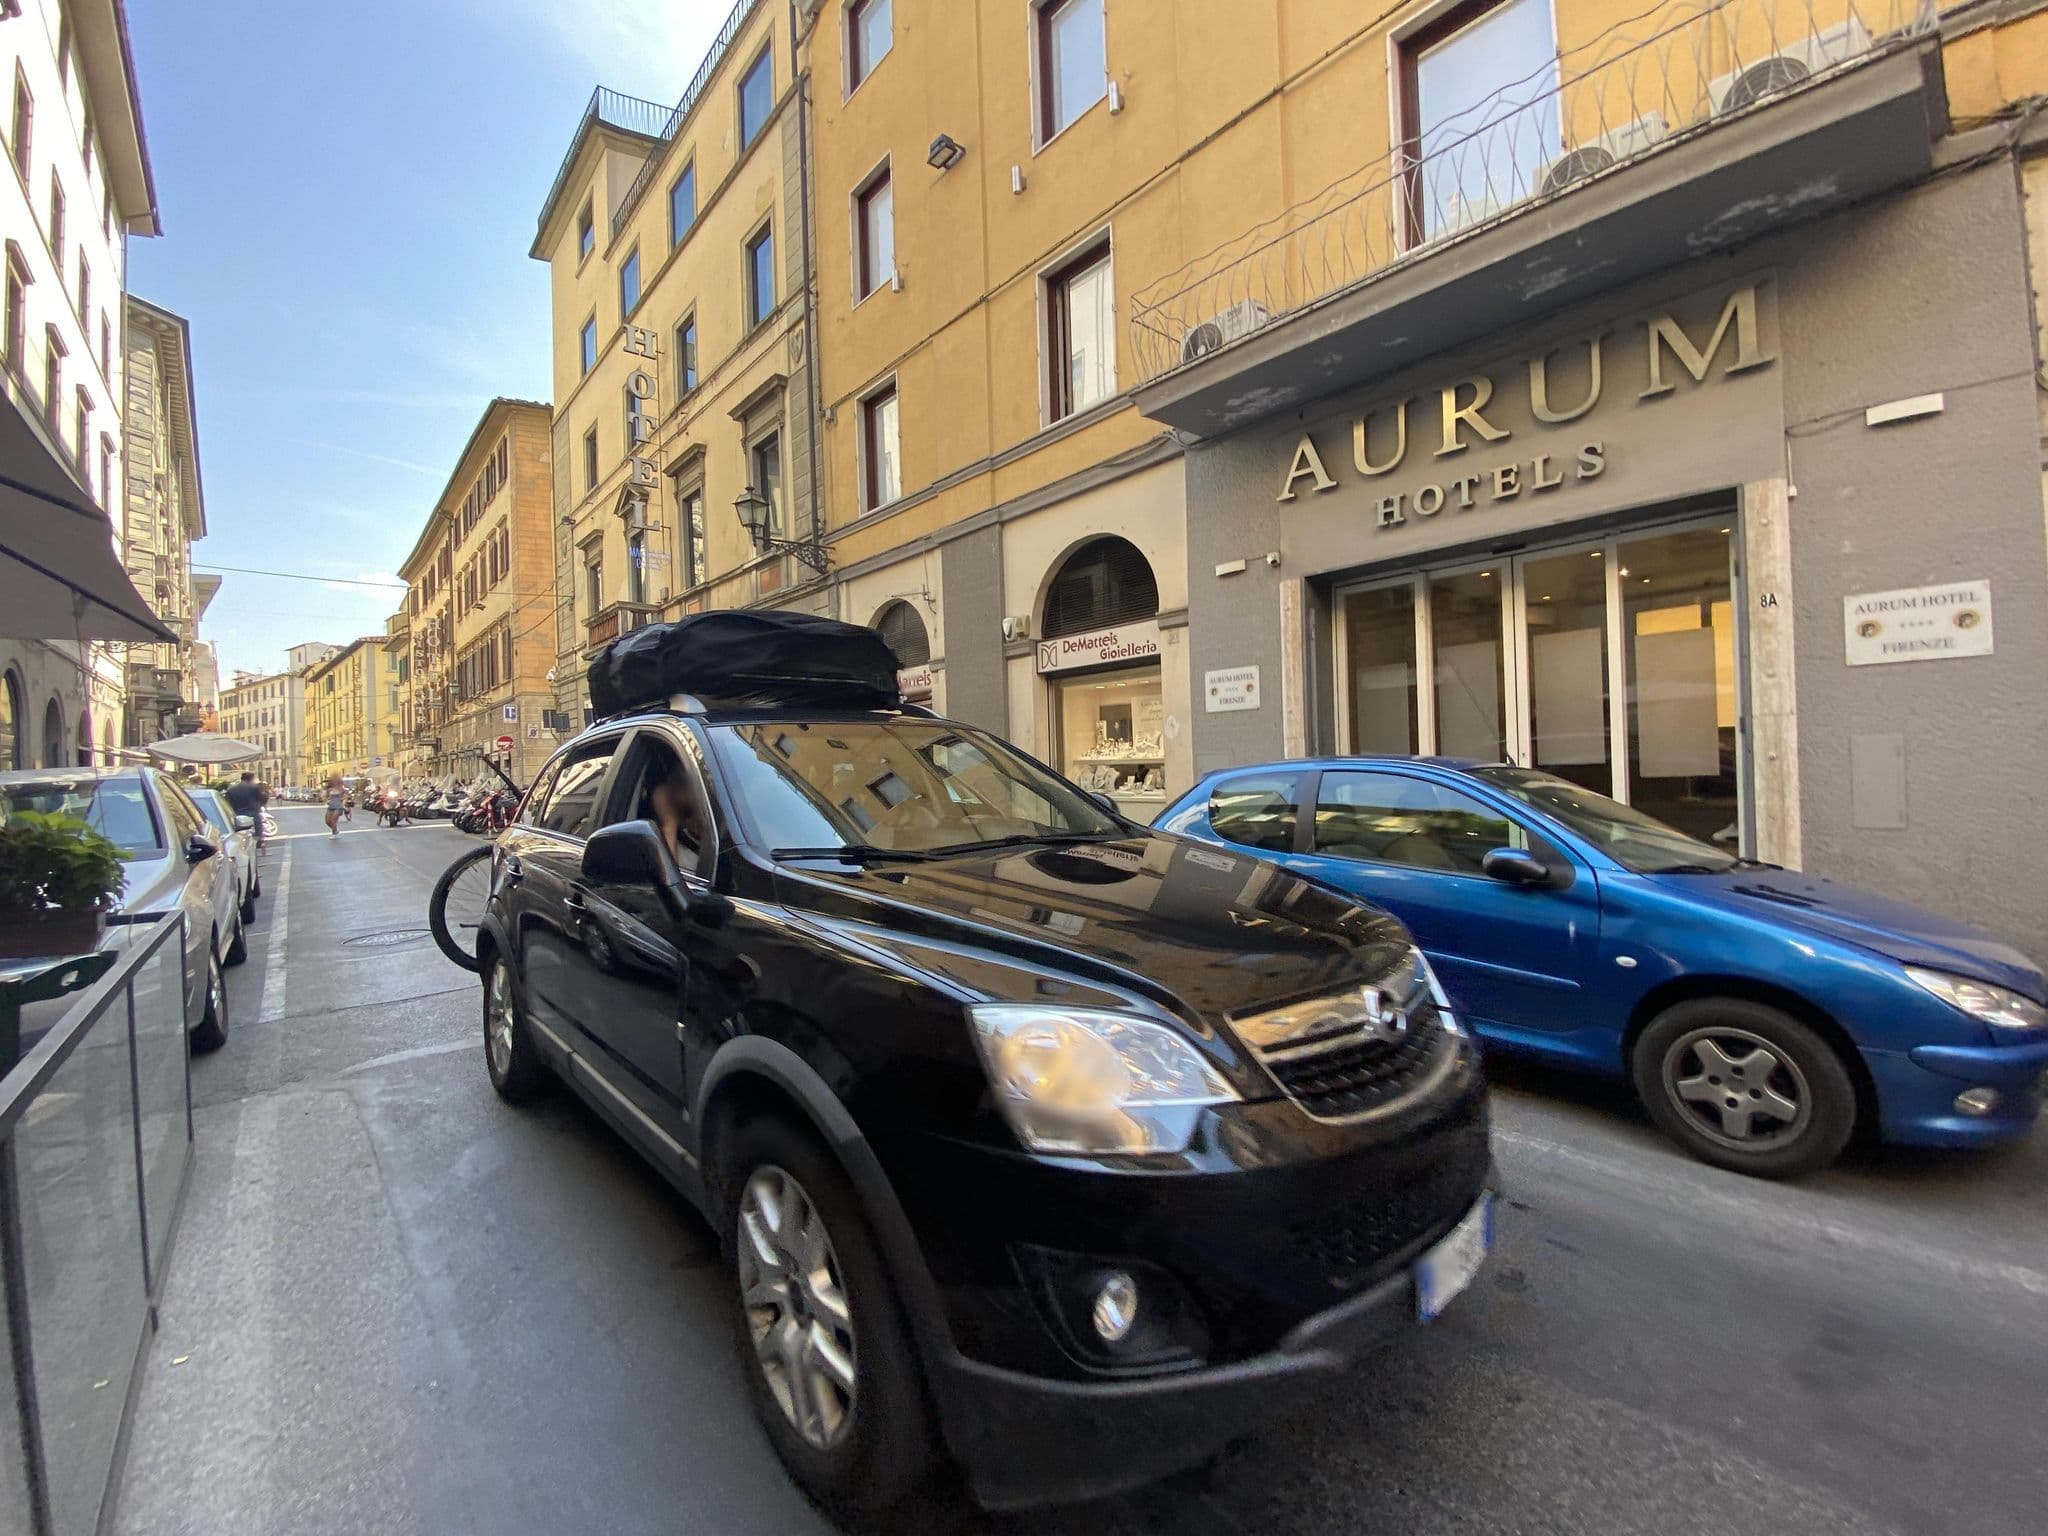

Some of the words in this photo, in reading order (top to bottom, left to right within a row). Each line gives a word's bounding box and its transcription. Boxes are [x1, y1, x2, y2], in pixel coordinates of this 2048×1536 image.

[1277, 286, 1776, 502] AURUM
[622, 323, 660, 532] HOTEL
[1373, 441, 1608, 529] HOTELS
[1760, 593, 1777, 608] 8A
[1855, 596, 1917, 616] AURUM
[1921, 591, 1982, 608] HOTEL
[1063, 632, 1118, 653] DeMatteis
[1099, 640, 1157, 660] Gioielleria
[1881, 637, 1955, 655] FIRENZE
[1209, 675, 1233, 684] AURUM
[1233, 673, 1255, 682] HOTEL
[1219, 696, 1245, 705] FIRENZE
